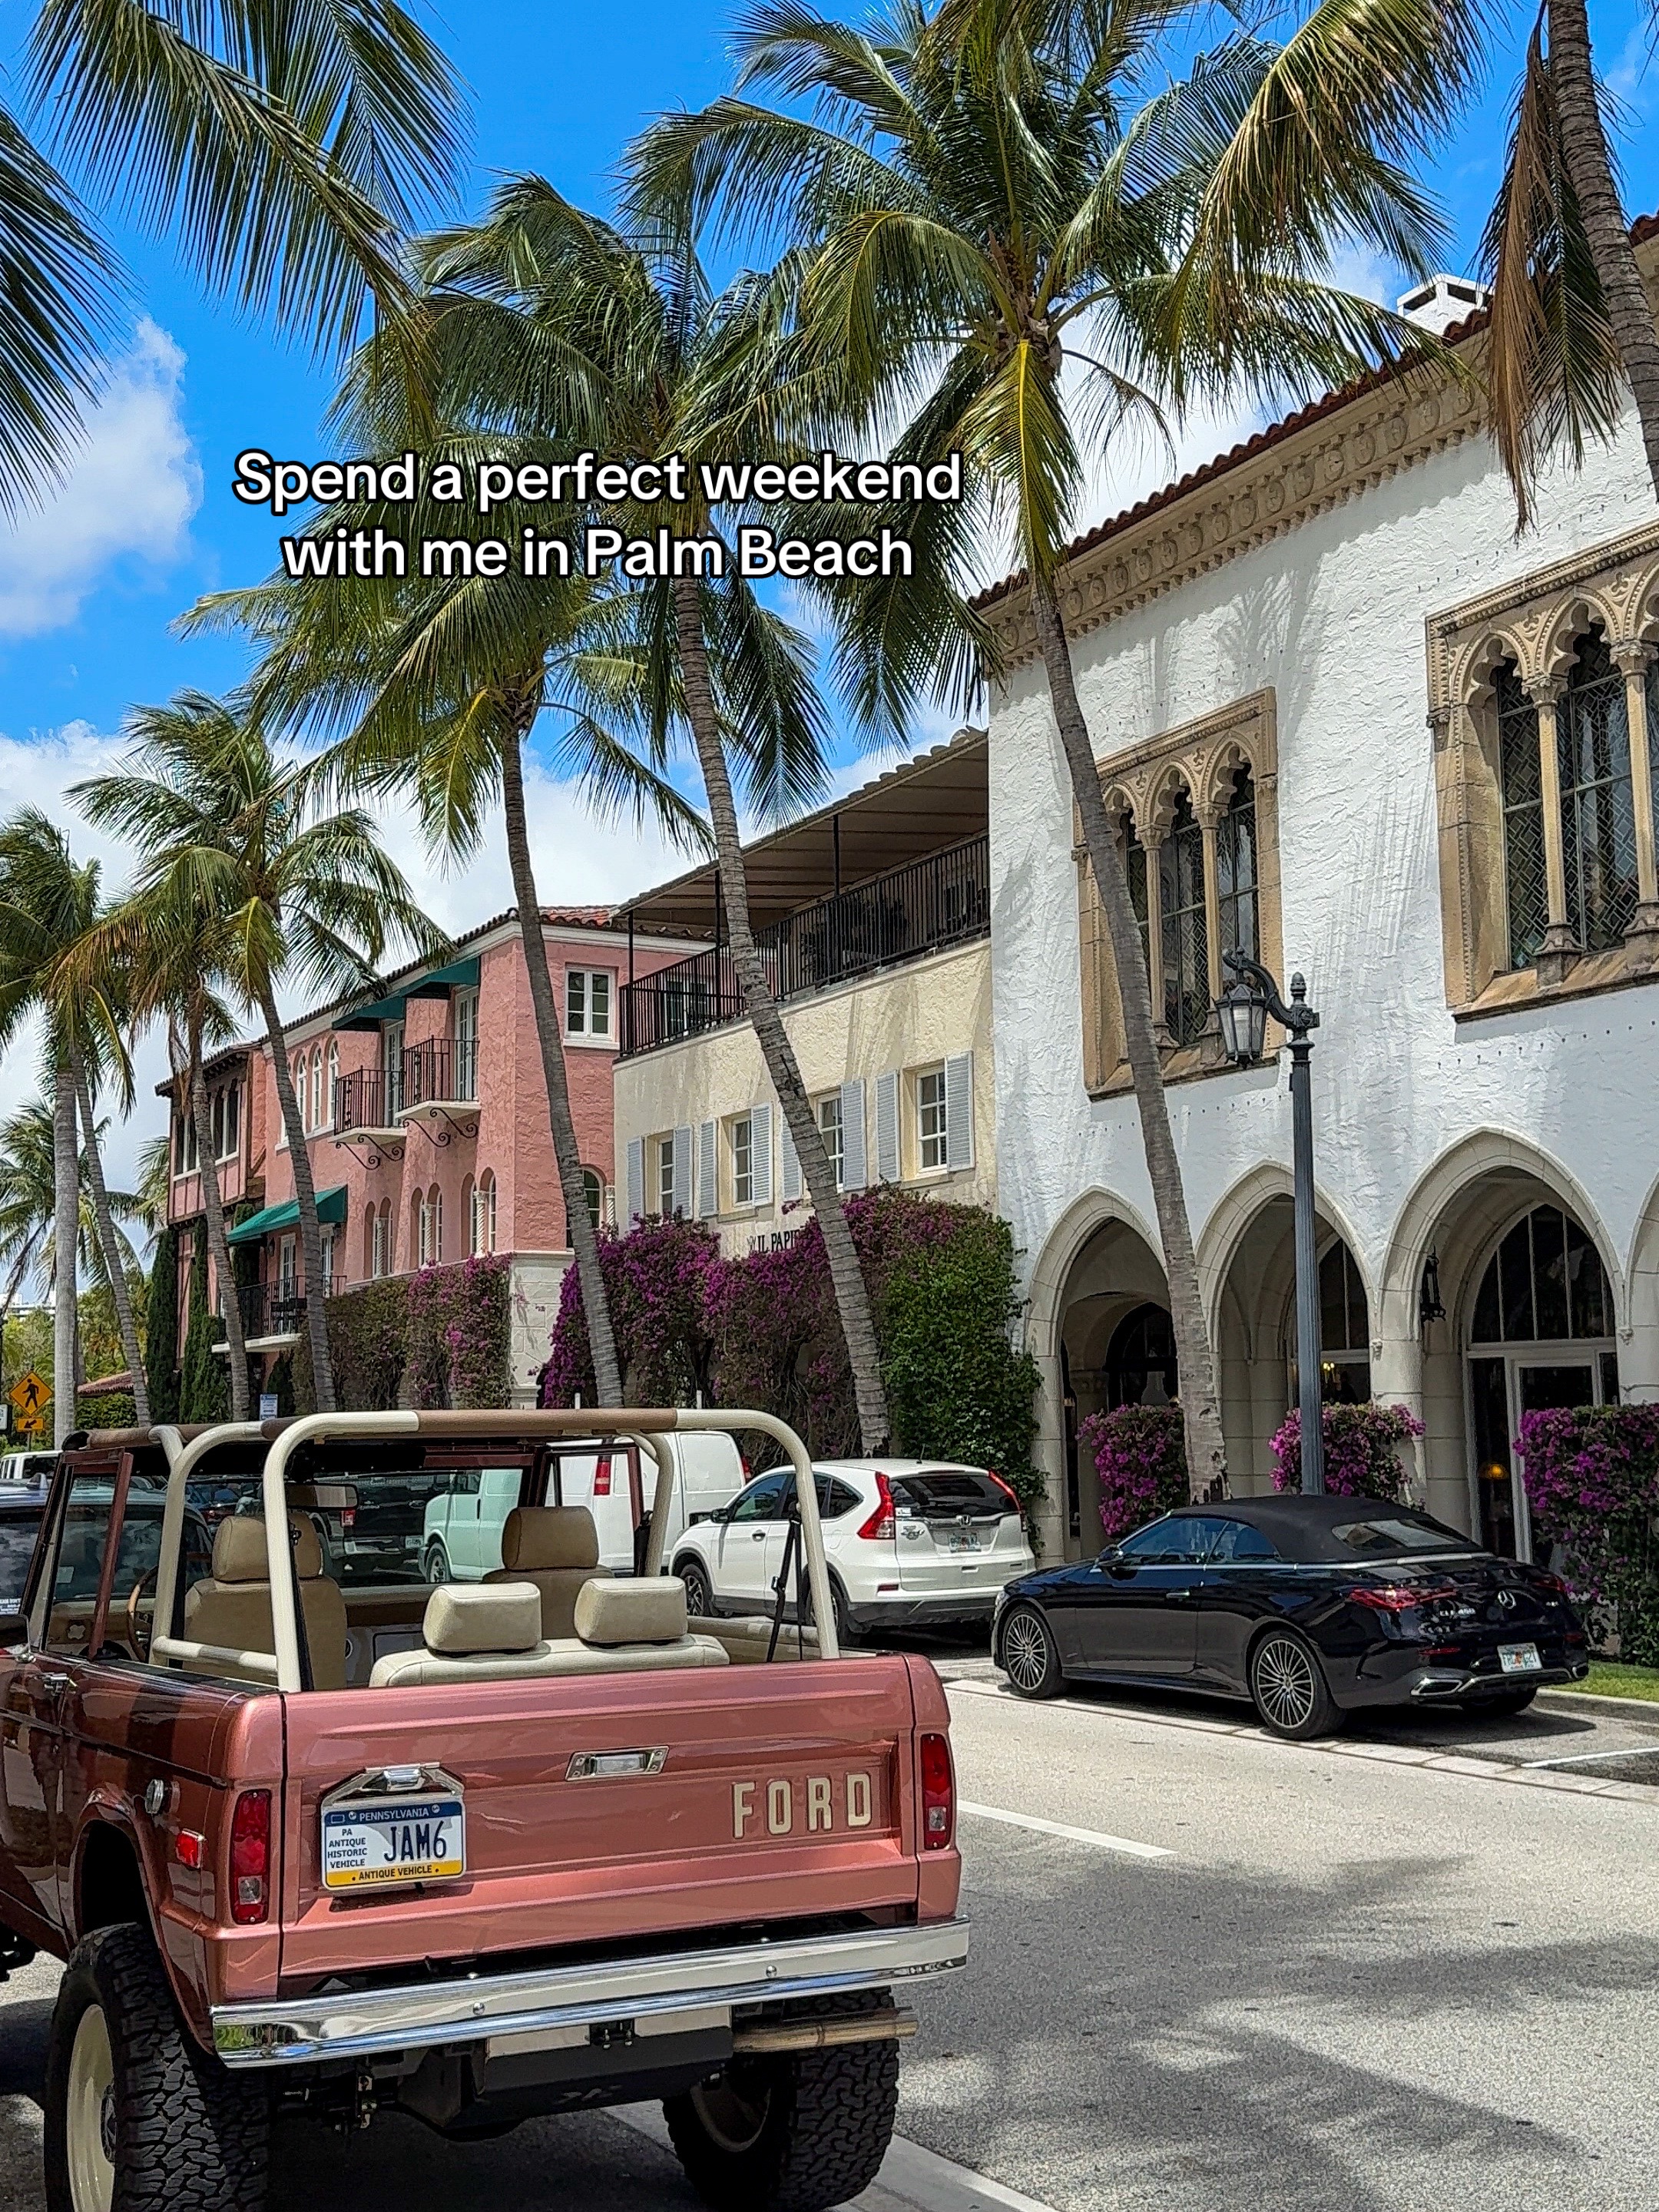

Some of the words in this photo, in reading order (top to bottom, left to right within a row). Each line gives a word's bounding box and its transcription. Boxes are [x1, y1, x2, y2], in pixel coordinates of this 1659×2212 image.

[757, 1235, 770, 1253] IL
[770, 1229, 800, 1252] PAPI
[732, 1771, 873, 1839] FORD
[359, 1807, 429, 1822] PENNSYLVANIA
[328, 1837, 366, 1847] ANTIQUE
[383, 1820, 447, 1862] JAM6
[327, 1847, 368, 1859] HISTORIC
[329, 1859, 365, 1869] VEHICLE
[358, 1868, 396, 1880] ANTIQUE
[397, 1865, 432, 1876] VEHICLE
